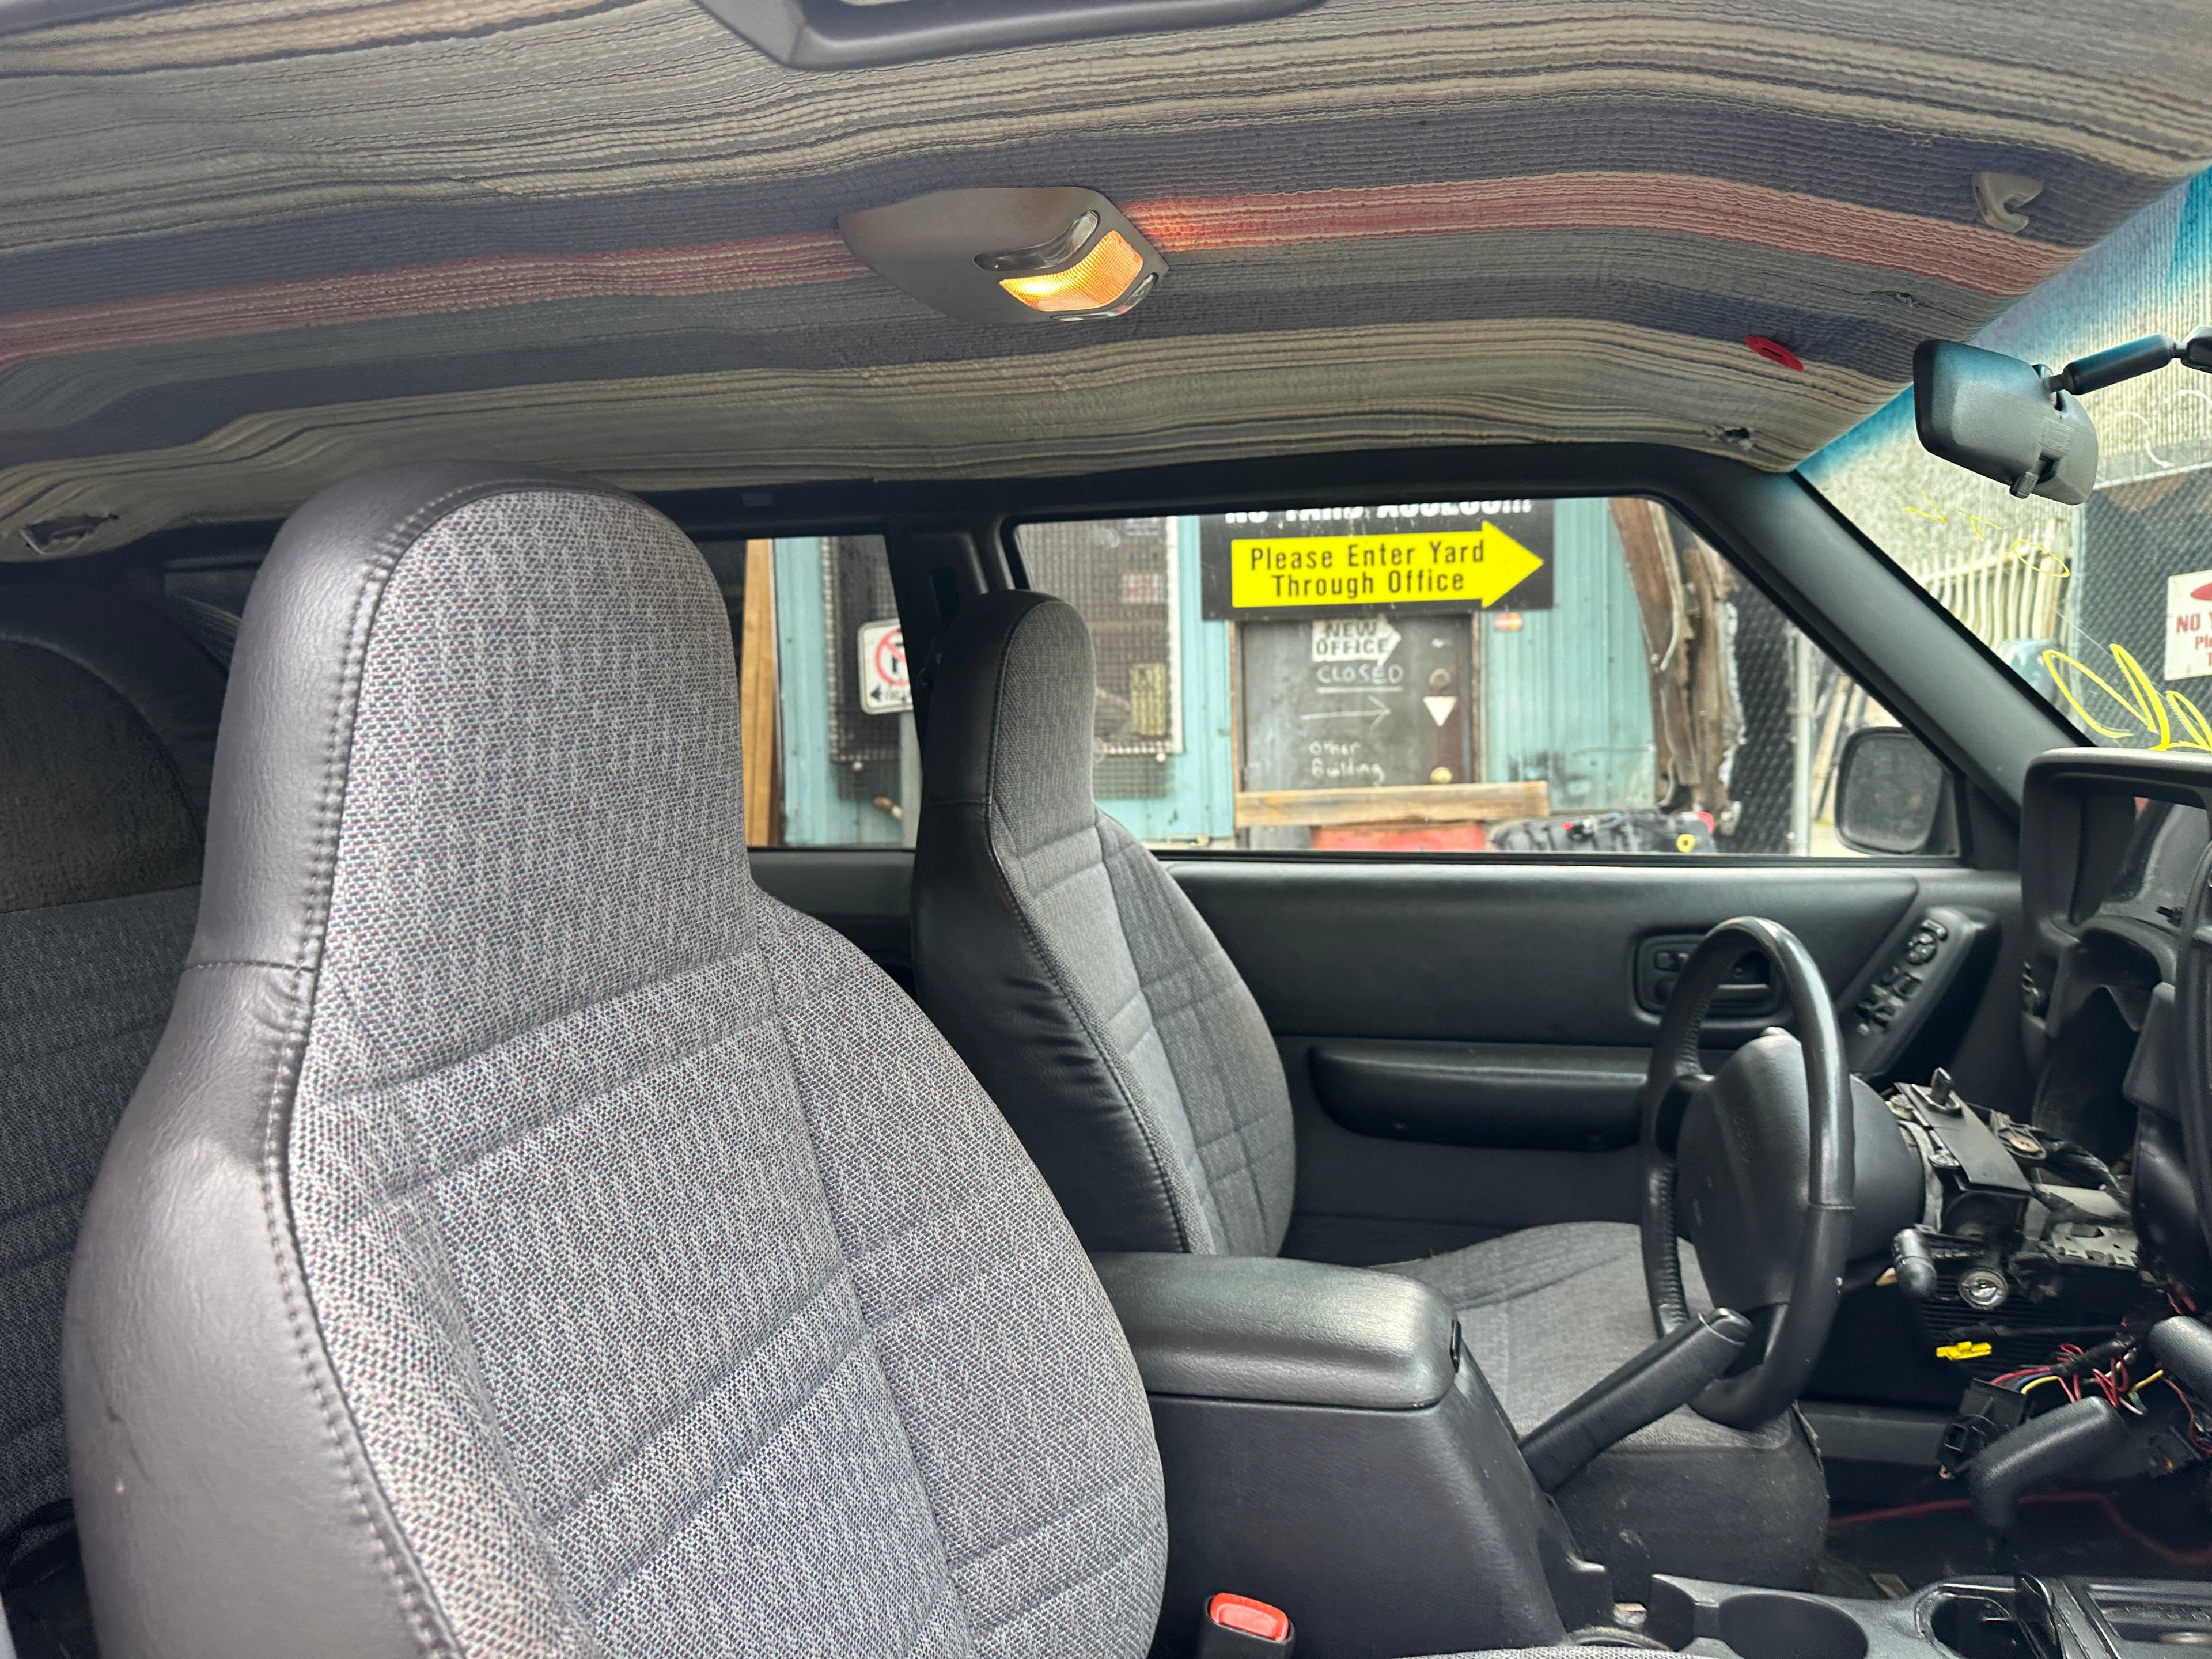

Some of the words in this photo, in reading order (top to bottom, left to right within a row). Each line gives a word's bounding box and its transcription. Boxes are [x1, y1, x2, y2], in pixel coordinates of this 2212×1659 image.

[1251, 546, 1333, 570] Please
[1347, 543, 1415, 566] Enter
[1429, 539, 1484, 564] Yard
[1271, 571, 1373, 599] Through
[1388, 569, 1464, 593] Office
[1326, 622, 1377, 638] NEW
[2176, 613, 2201, 633] NO
[1316, 638, 1388, 655] OFFICE
[1317, 664, 1404, 684] CLOSED
